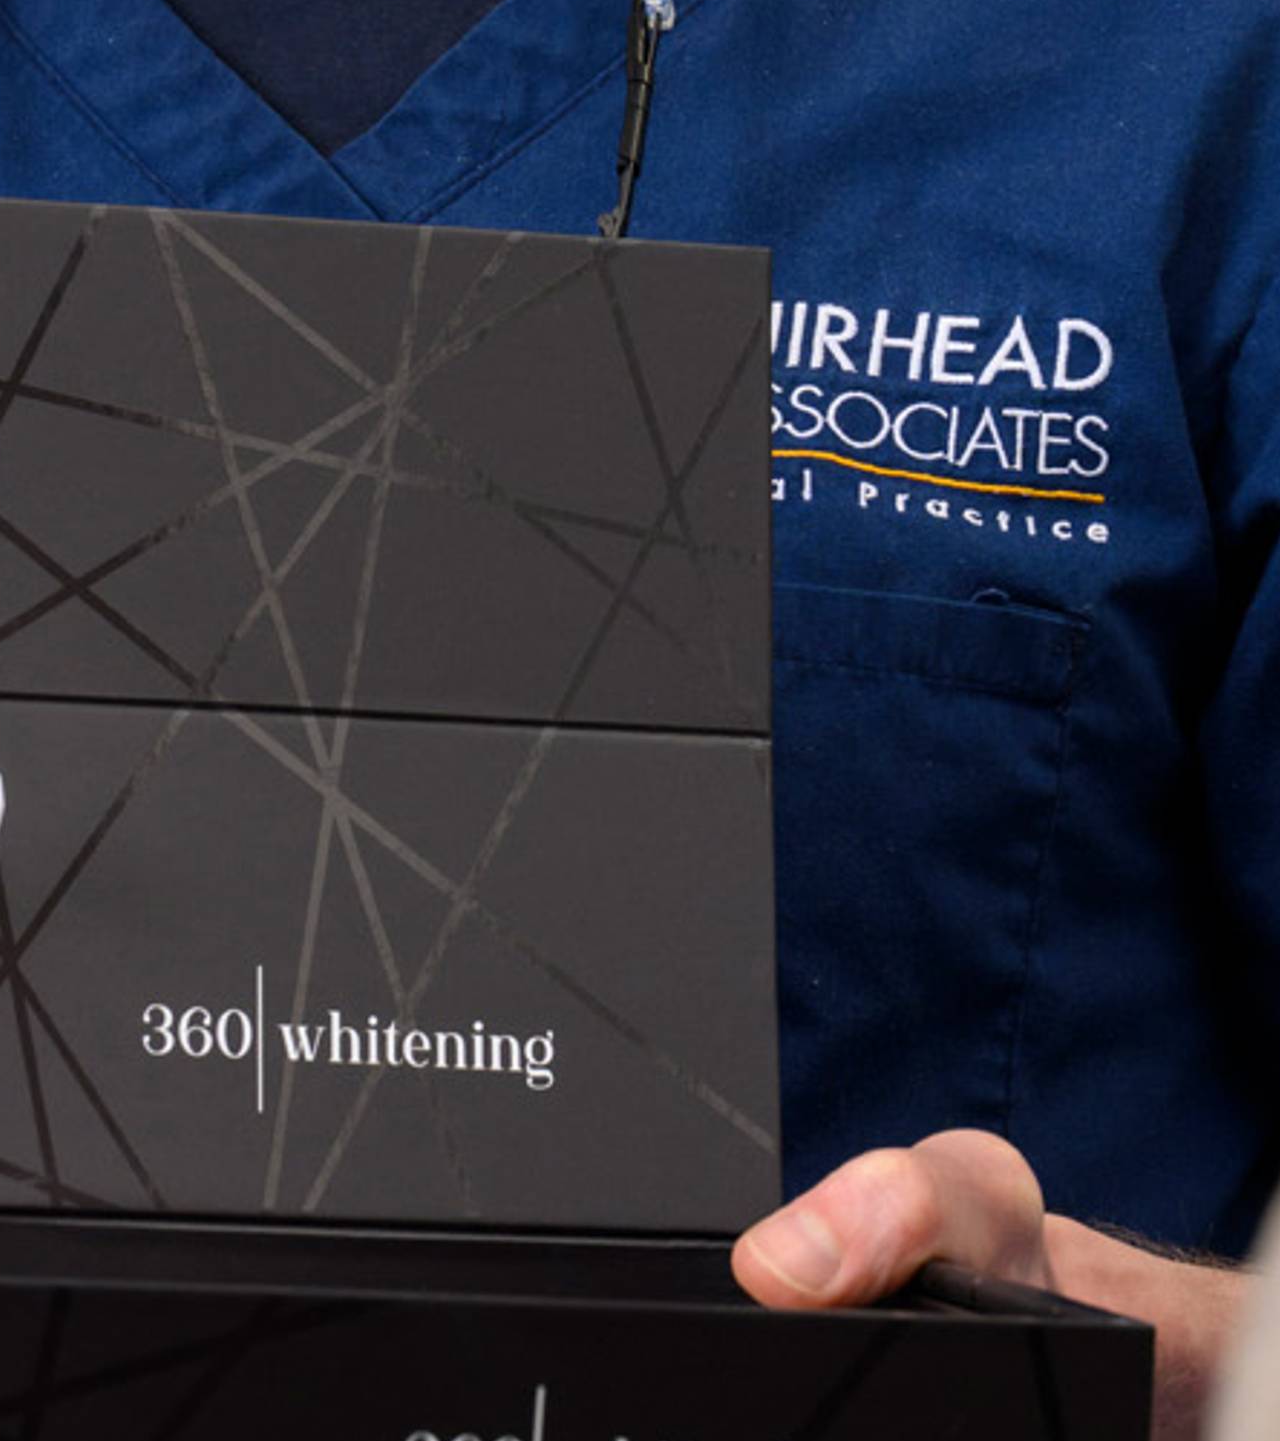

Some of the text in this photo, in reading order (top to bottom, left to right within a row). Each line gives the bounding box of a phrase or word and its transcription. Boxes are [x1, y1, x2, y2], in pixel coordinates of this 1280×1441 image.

[859, 481, 1110, 543] Practice
[141, 1002, 556, 1091] 360 whitening
